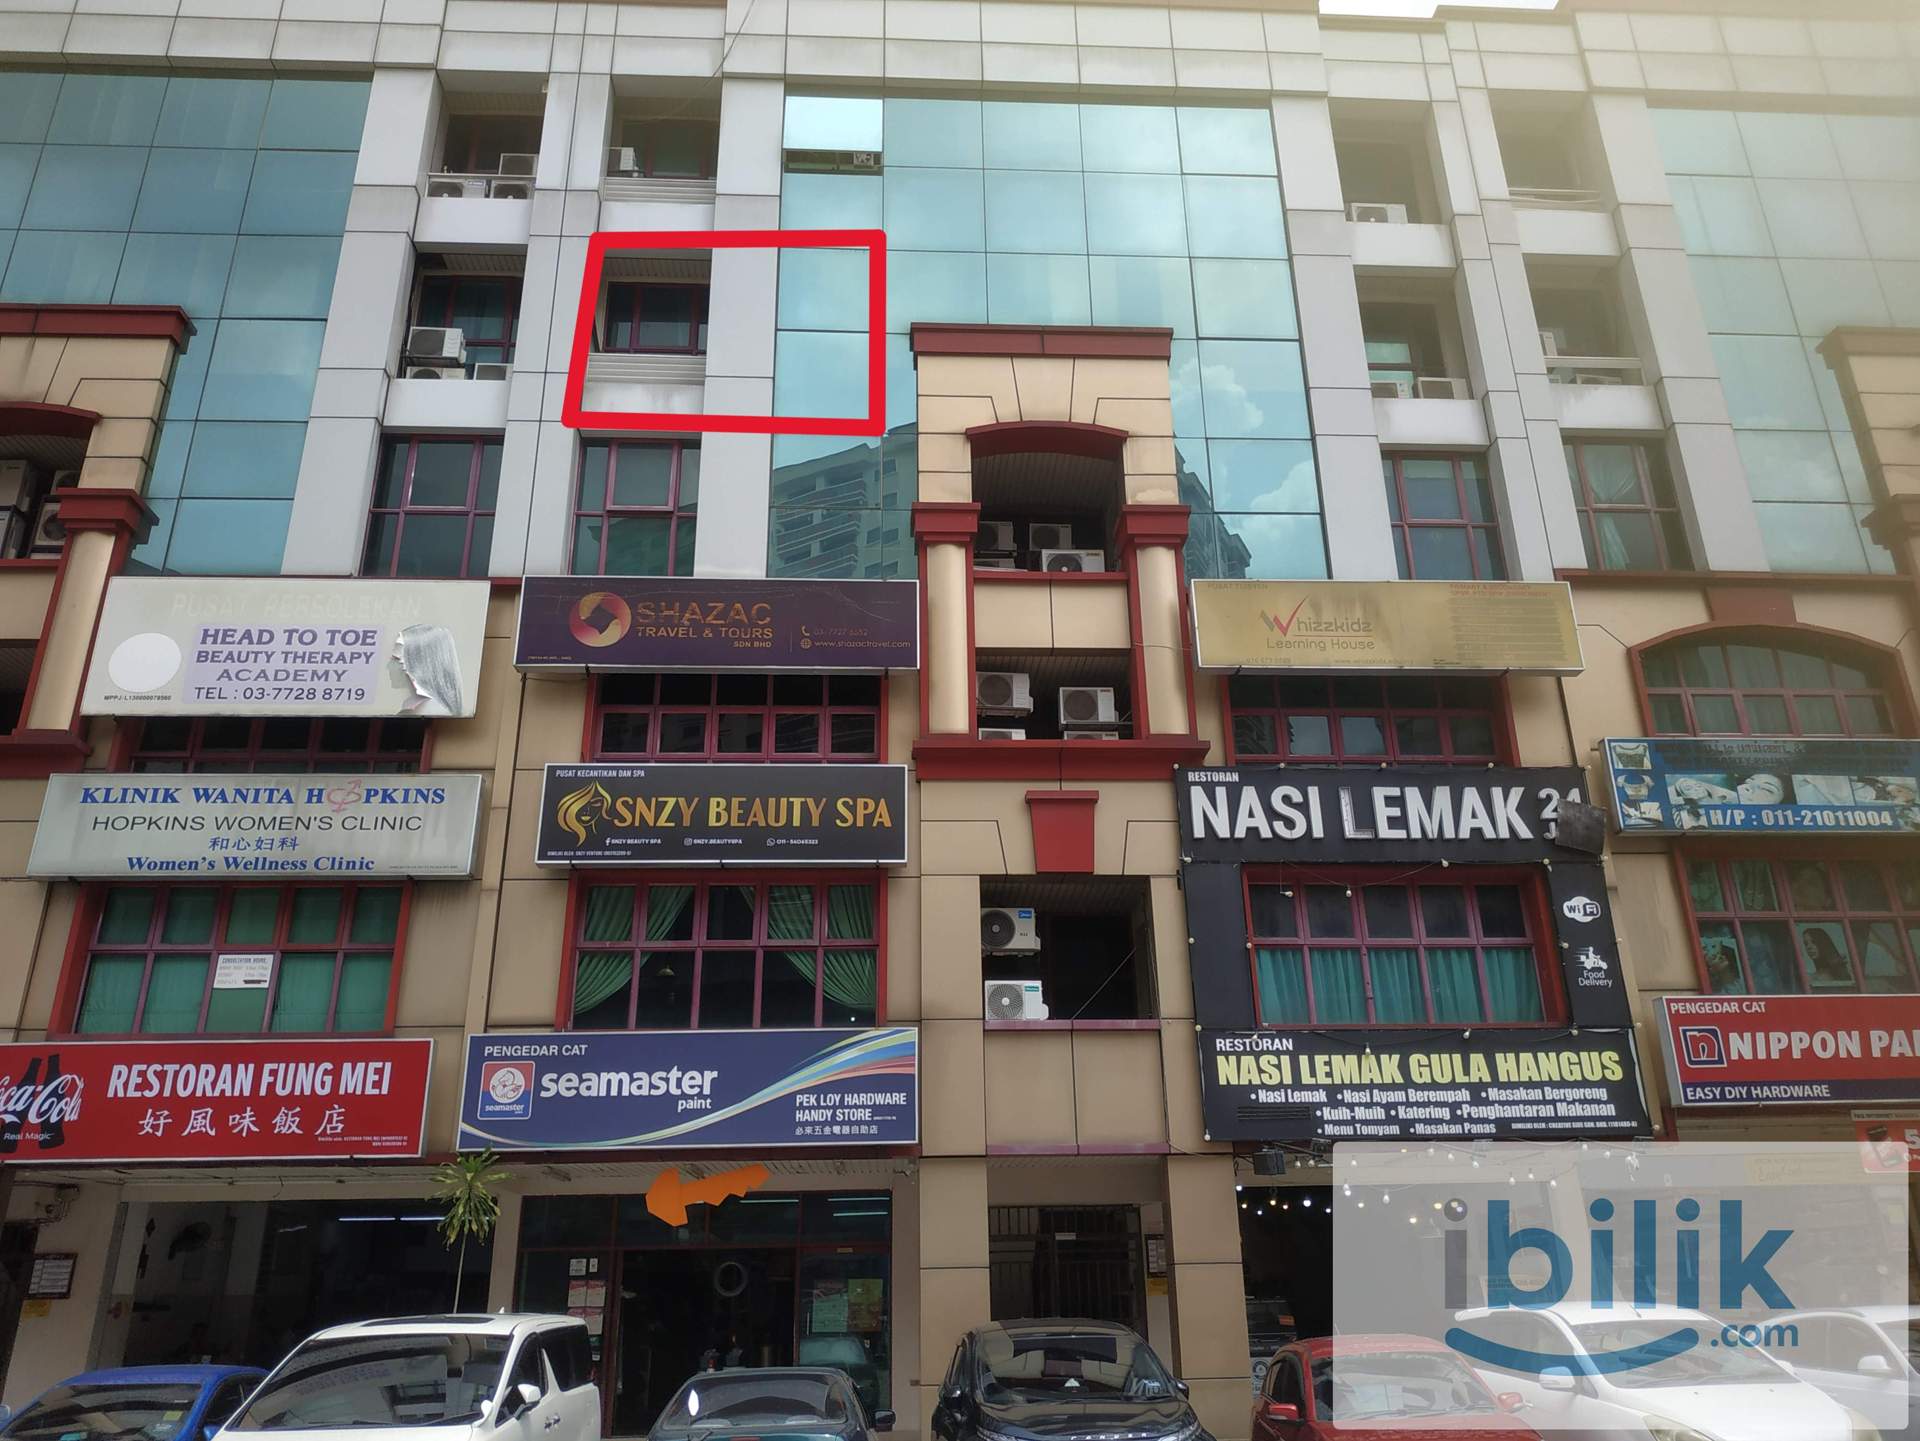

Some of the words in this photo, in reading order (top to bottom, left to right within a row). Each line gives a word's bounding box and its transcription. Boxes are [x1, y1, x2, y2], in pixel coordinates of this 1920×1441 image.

[637, 601, 772, 625] SHAZAC
[200, 628, 274, 646] HEAD
[284, 629, 317, 647] TO
[326, 629, 378, 647] TOE
[636, 626, 697, 638] TRAVEL
[702, 627, 712, 638] &
[720, 626, 773, 639] TOURS
[1267, 637, 1327, 651] Learning
[1331, 637, 1375, 650] House
[195, 650, 275, 664] BEAUTY
[282, 651, 375, 665] THERAPY
[216, 668, 349, 682] ACADEMY
[194, 687, 228, 700] TEL
[242, 687, 317, 701] 03-7728
[322, 687, 366, 701] 8719
[556, 769, 576, 778] PUSAT
[577, 769, 617, 778] KECANTIKAN
[619, 769, 632, 778] DAN
[633, 769, 645, 778] SPA
[1188, 771, 1239, 782] RESTORAN
[80, 787, 183, 804] KLINIK
[192, 787, 296, 804] WANITA
[614, 796, 700, 828] SNZY
[707, 796, 827, 828] BEAUTY
[835, 796, 893, 828] SPA
[1190, 785, 1324, 839] NASI
[1338, 785, 1535, 840] LEMAK
[1709, 809, 1745, 826] H/P
[1761, 809, 1893, 826] 011-21011004
[92, 815, 205, 832] HOPKINS
[214, 815, 333, 832] WOMEN'S
[341, 815, 422, 832] CLINIC
[209, 836, 299, 851] 和心妇科
[127, 856, 216, 872] Women's
[223, 856, 307, 872] Wellness
[314, 856, 375, 871] Clinic
[1583, 970, 1605, 978] Food
[1578, 978, 1613, 988] Delivery
[1670, 1002, 1740, 1014] PENGEDAR
[1743, 1001, 1766, 1013] CAT
[484, 1045, 559, 1057] PENGEDAR
[562, 1045, 588, 1056] CAT
[1215, 1038, 1294, 1052] RESTORAN
[1728, 1030, 1862, 1060] NIPPON
[1216, 1054, 1294, 1086] NASI
[1299, 1053, 1405, 1085] LEMAK
[1409, 1052, 1492, 1084] GULA
[1495, 1051, 1624, 1083] HANGUS
[107, 1063, 255, 1098] RESTORAN
[259, 1062, 335, 1097] FUNG
[338, 1061, 393, 1095] MEI
[539, 1064, 719, 1098] seamaster
[795, 1093, 818, 1107] PEK
[820, 1093, 841, 1106] LOY
[844, 1092, 908, 1105] HARDWARE
[1258, 1088, 1285, 1102] Nasi
[1287, 1088, 1327, 1102] Lemak
[1343, 1089, 1371, 1103] Nasi
[1372, 1088, 1407, 1105] Ayam
[1408, 1087, 1470, 1104] Berempah
[1487, 1087, 1543, 1101] Masakan
[1545, 1086, 1608, 1103] Bergoreng
[1686, 1087, 1722, 1100] EASY
[1725, 1086, 1747, 1099] DIY
[1751, 1084, 1831, 1099] HARDWARE
[677, 1096, 712, 1112] paint
[1322, 1106, 1386, 1121] Kuih-Muih
[1397, 1105, 1451, 1121] Katering
[1462, 1103, 1555, 1119] Penghantaran
[1556, 1102, 1617, 1117] Makanan
[137, 1104, 346, 1137] 好風味飯店
[795, 1109, 834, 1122] HANDY
[836, 1108, 872, 1121] STORE
[3, 1132, 23, 1140] Real
[25, 1132, 52, 1141] Magic
[1325, 1123, 1354, 1136] Menu
[1355, 1123, 1400, 1137] Tomyam
[1415, 1122, 1462, 1135] Masakan
[1464, 1121, 1497, 1134] Panas
